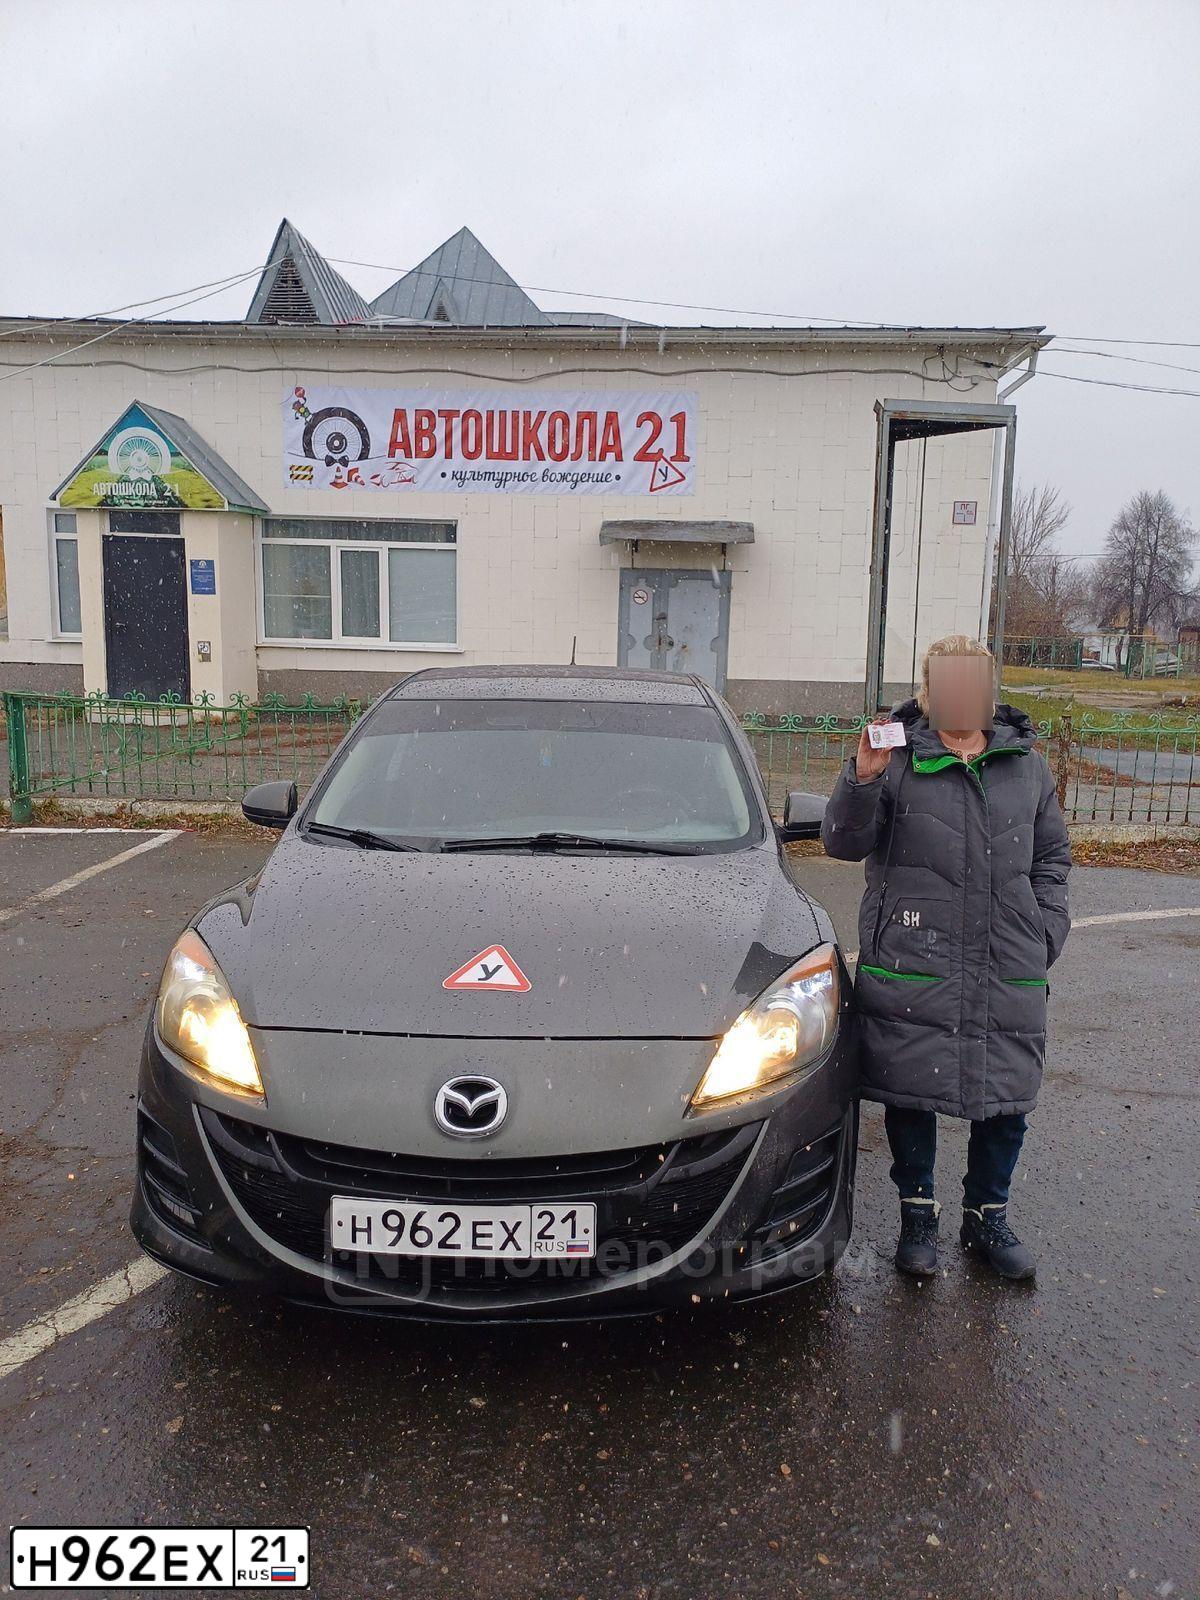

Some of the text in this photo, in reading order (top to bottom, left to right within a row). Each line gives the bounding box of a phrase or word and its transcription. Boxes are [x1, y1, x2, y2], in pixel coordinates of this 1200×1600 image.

[387, 408, 691, 462] АВТОШКОЛА 21
[451, 468, 613, 489] культурное вождение
[93, 482, 180, 498] АВТОШКОЛА 21
[536, 1209, 577, 1240] 21
[534, 1241, 565, 1253] RUS
